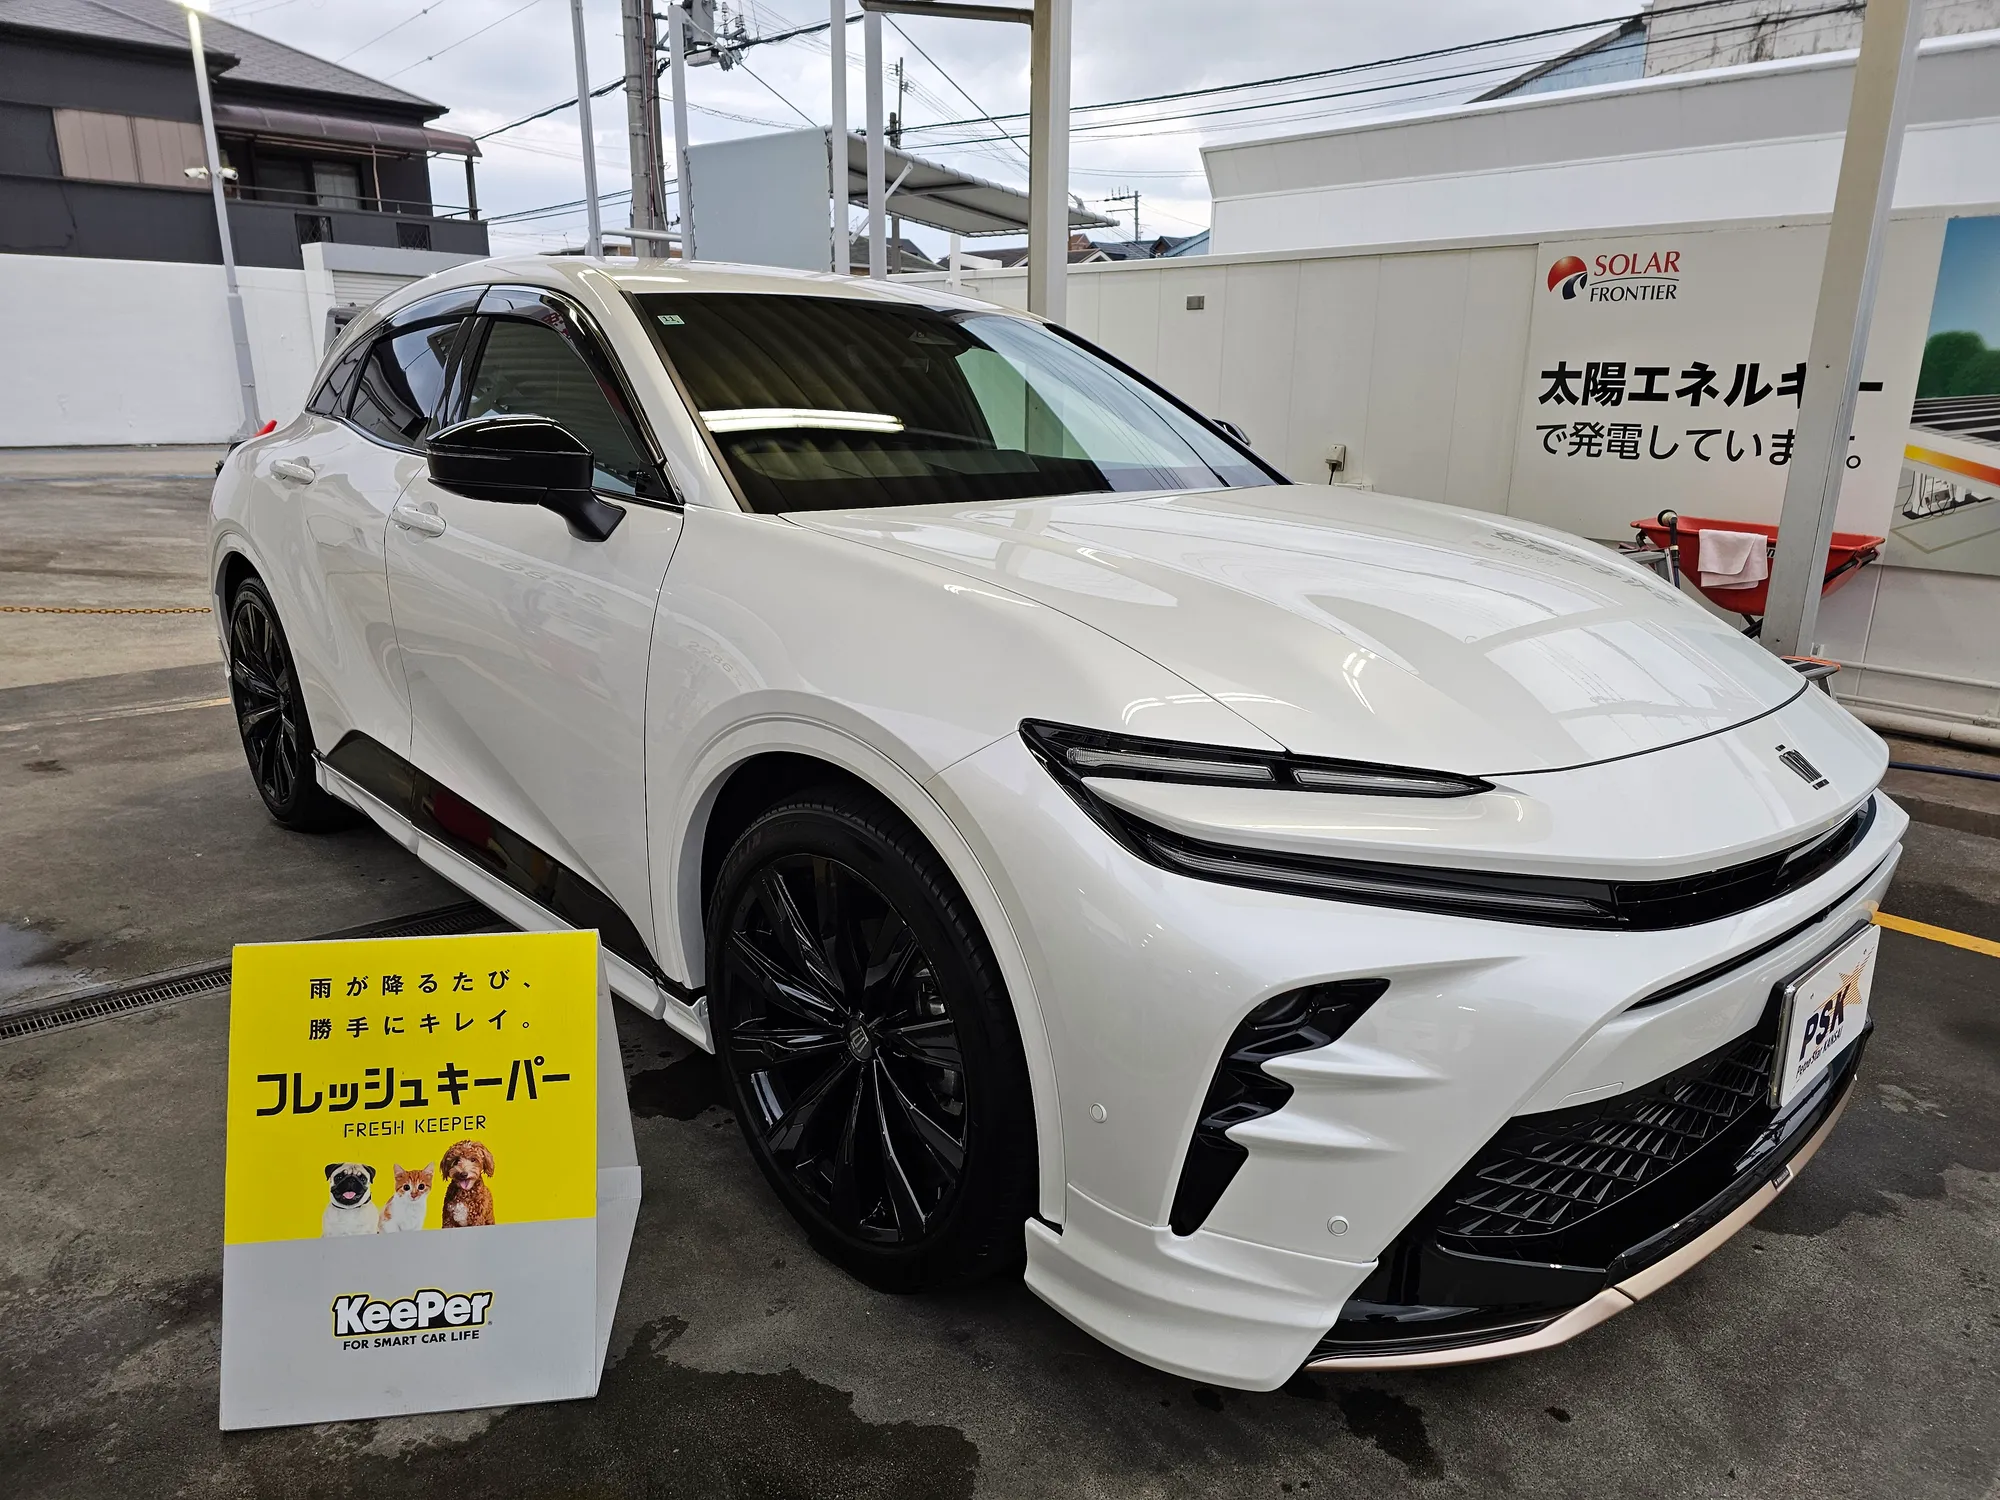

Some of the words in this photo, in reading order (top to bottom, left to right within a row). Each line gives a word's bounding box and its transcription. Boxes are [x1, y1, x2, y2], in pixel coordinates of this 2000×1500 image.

[1593, 250, 1681, 277] SOLAR
[1589, 283, 1678, 303] FRONTIER
[1535, 421, 1861, 469] で発電していま。
[309, 968, 531, 1000] 雨が降るたび、
[308, 1008, 530, 1041] 勝手にキレイ。
[1800, 983, 1851, 1061] PSK
[256, 1055, 571, 1117] フレッシュキーパー
[343, 1119, 404, 1138] FRESH
[414, 1115, 487, 1134] KEEPER
[333, 1288, 492, 1336] KeePer
[343, 1340, 369, 1350] FOR
[374, 1335, 417, 1348] SMART
[421, 1333, 446, 1344] CAR
[451, 1330, 480, 1341] LIFE
